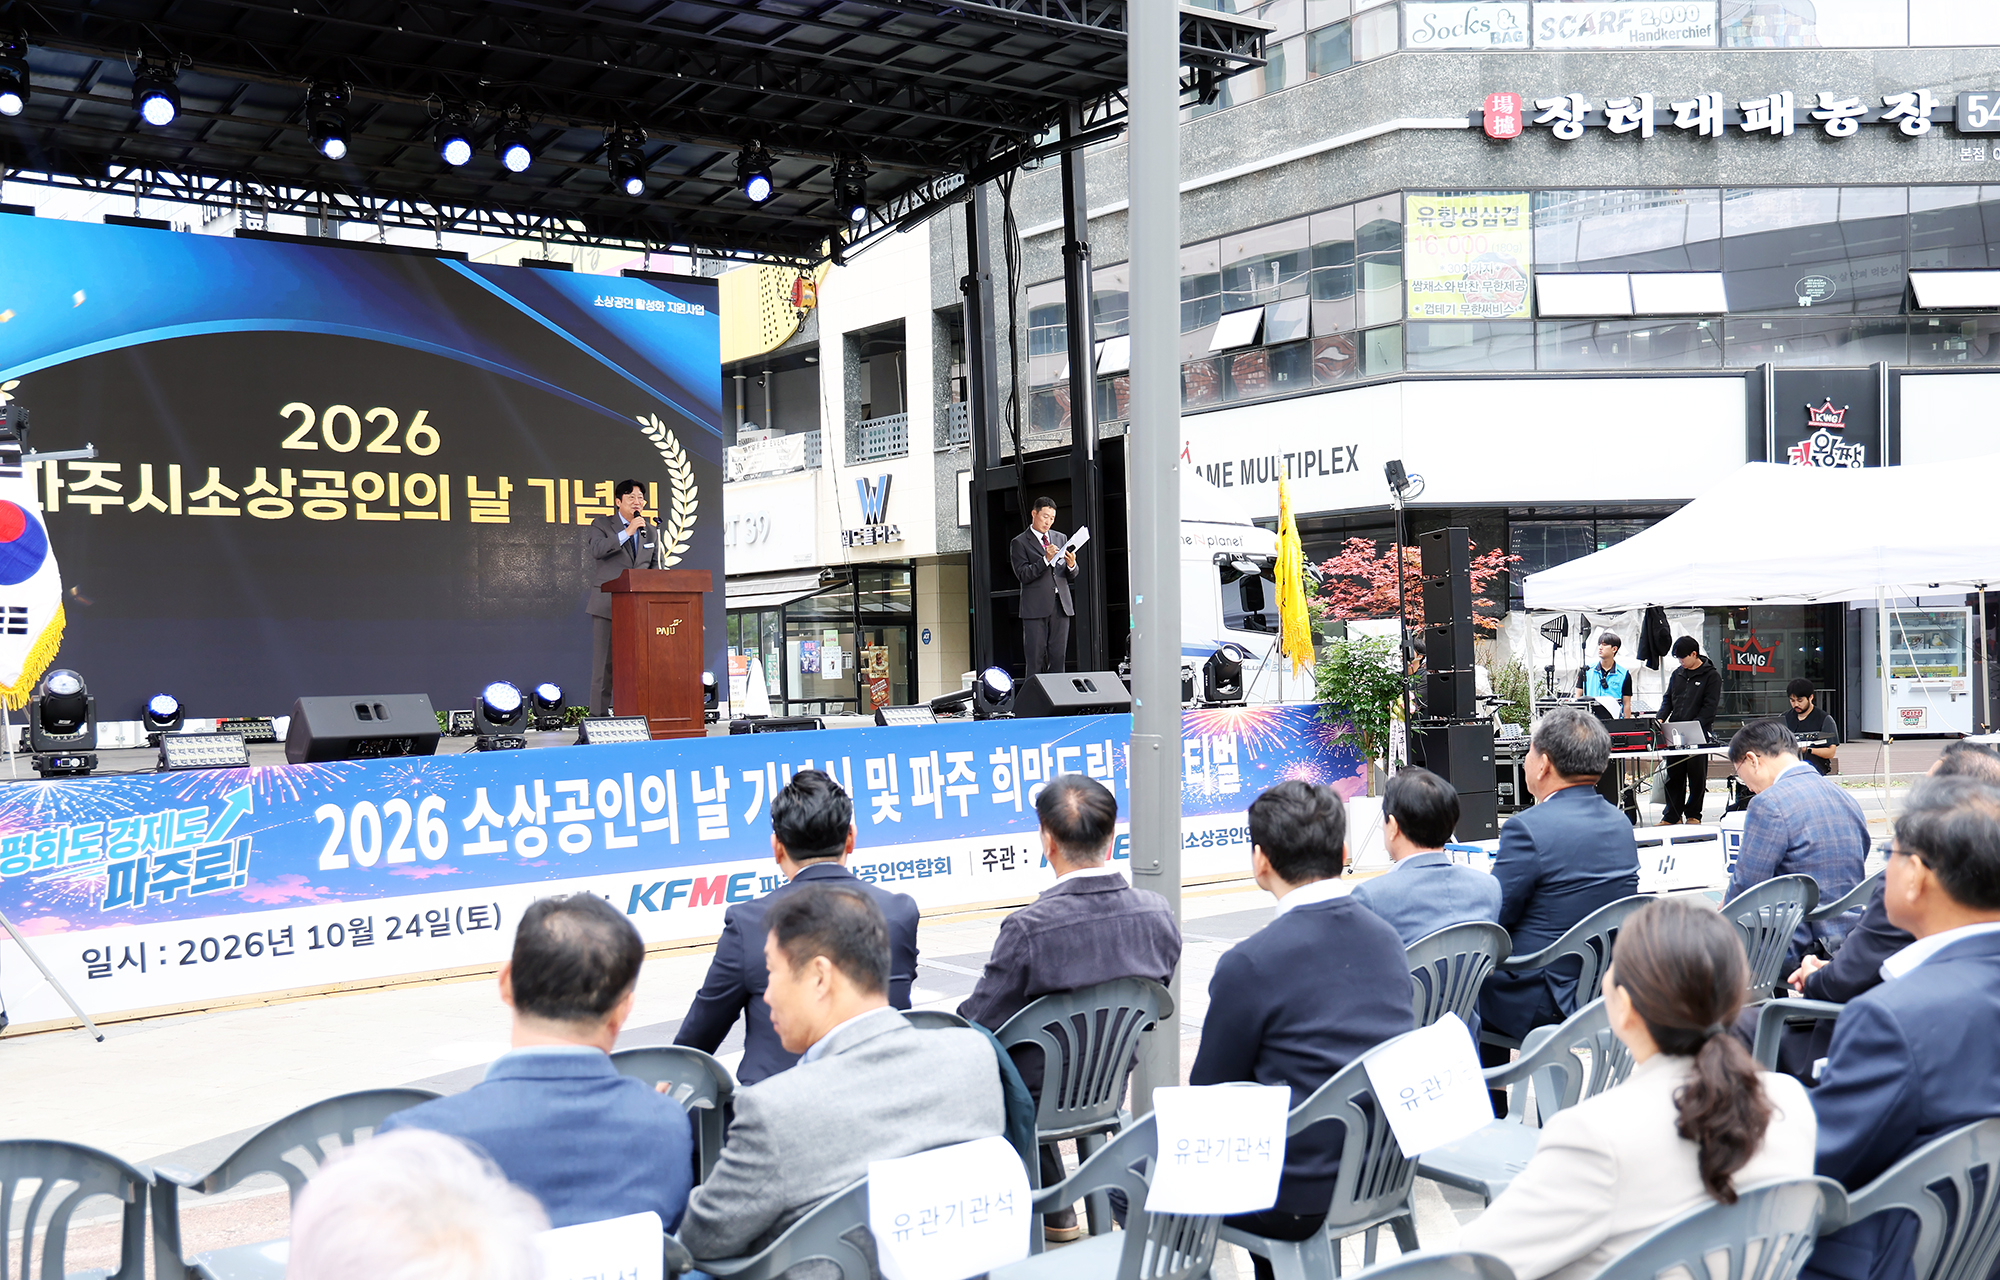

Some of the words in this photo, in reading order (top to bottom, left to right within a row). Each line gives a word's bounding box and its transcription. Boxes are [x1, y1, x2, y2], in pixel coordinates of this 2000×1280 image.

[1412, 6, 1491, 43] Socks
[1539, 8, 1634, 41] SCARF
[1640, 5, 1699, 27] 2,000
[1490, 31, 1523, 44] BAG
[1629, 25, 1711, 42] Handkerchief
[1532, 88, 1940, 140] 장터대패농장
[1960, 146, 1985, 162] 본점
[1417, 206, 1520, 228] 유황생삼겹
[1415, 234, 1488, 256] 16,000
[1491, 242, 1523, 254] (180g)
[1481, 280, 1527, 292] 무한제공
[594, 295, 634, 310] 소상공인
[635, 298, 666, 313] 활성화
[667, 301, 705, 316] 지원사업
[1460, 303, 1515, 315] 무한써비스
[279, 402, 441, 457] 2026
[1240, 444, 1359, 486] MULTIPLEX
[467, 475, 513, 524] 날
[656, 626, 676, 636] PAJU
[1736, 652, 1766, 667] KING
[314, 795, 450, 871] 2026
[462, 768, 680, 859] 소상공인의
[690, 765, 730, 841] 날
[865, 753, 902, 825] 및
[908, 750, 980, 820] 파주
[0, 821, 104, 878] 평화도
[105, 806, 209, 860] 경제도
[982, 845, 1016, 873] 주관
[100, 836, 253, 912] 파주로!
[626, 871, 757, 914] KFME
[82, 942, 147, 980] 일시
[177, 924, 296, 967] 2026년
[307, 916, 375, 951] 10월
[385, 902, 502, 938] 24일(토)
[1174, 1136, 1272, 1165] 유관기관석
[891, 1189, 1015, 1243] 유관기관석
